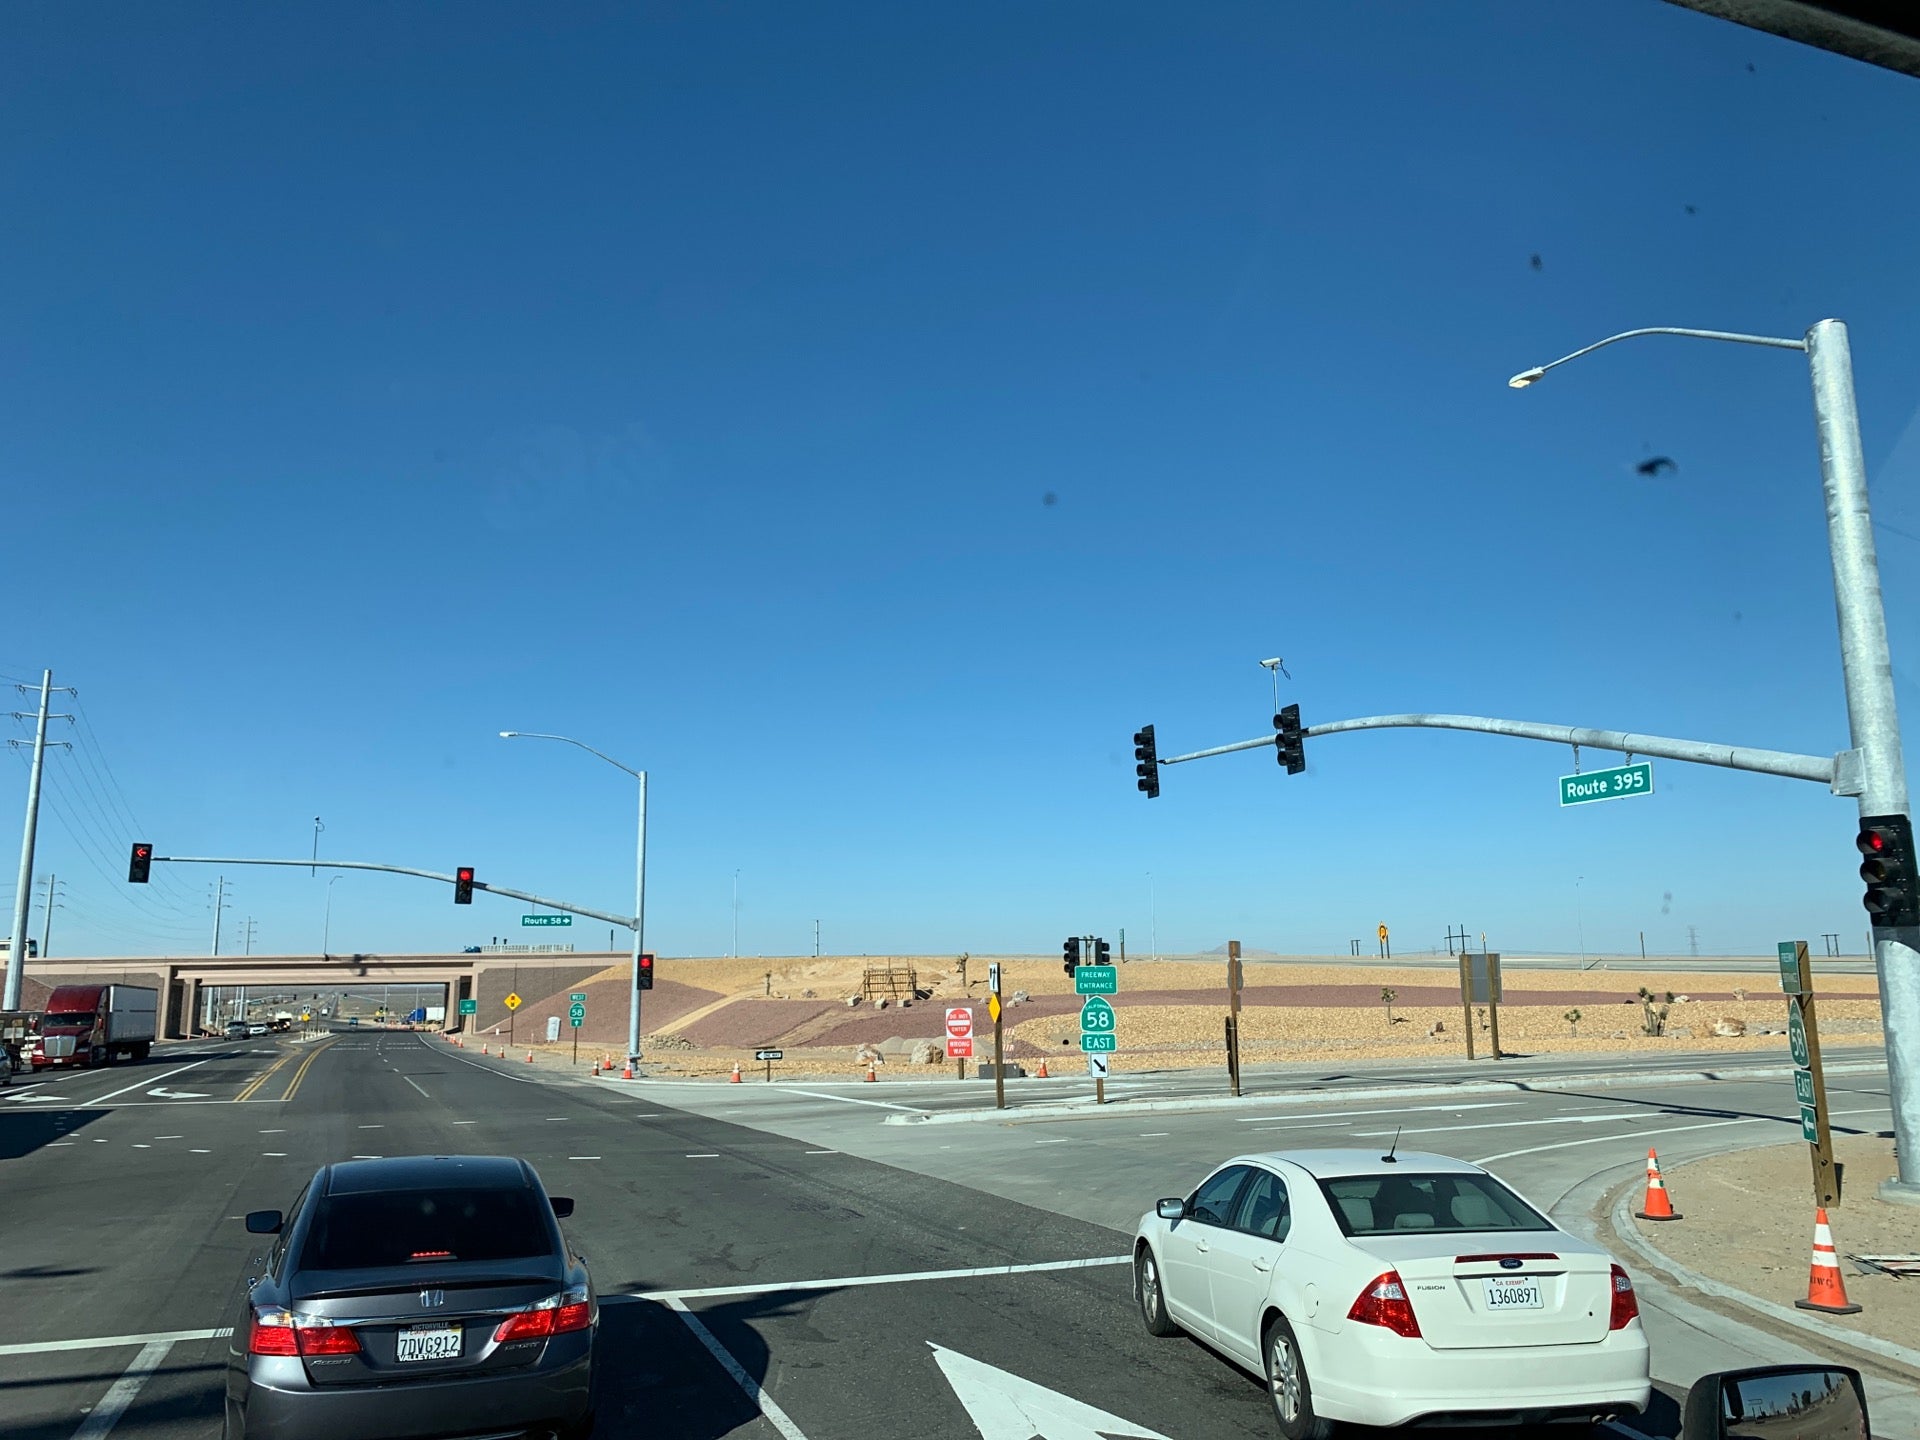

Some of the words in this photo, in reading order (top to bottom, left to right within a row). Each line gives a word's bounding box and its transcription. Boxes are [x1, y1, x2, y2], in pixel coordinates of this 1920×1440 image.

[1567, 779, 1607, 798] Route
[1614, 771, 1644, 791] 395
[524, 917, 548, 925] Route
[550, 917, 561, 925] 58
[571, 1008, 583, 1017] 58
[1087, 1011, 1109, 1028] 58
[1086, 1036, 1111, 1049] EAST
[1791, 1027, 1806, 1057] 58
[1796, 1074, 1812, 1098] EAST
[1489, 1287, 1538, 1305] 1360897
[400, 1335, 459, 1356] 7DVG912
[310, 1357, 353, 1367] Accord
[398, 1350, 459, 1362] VALLEYHI.COM
